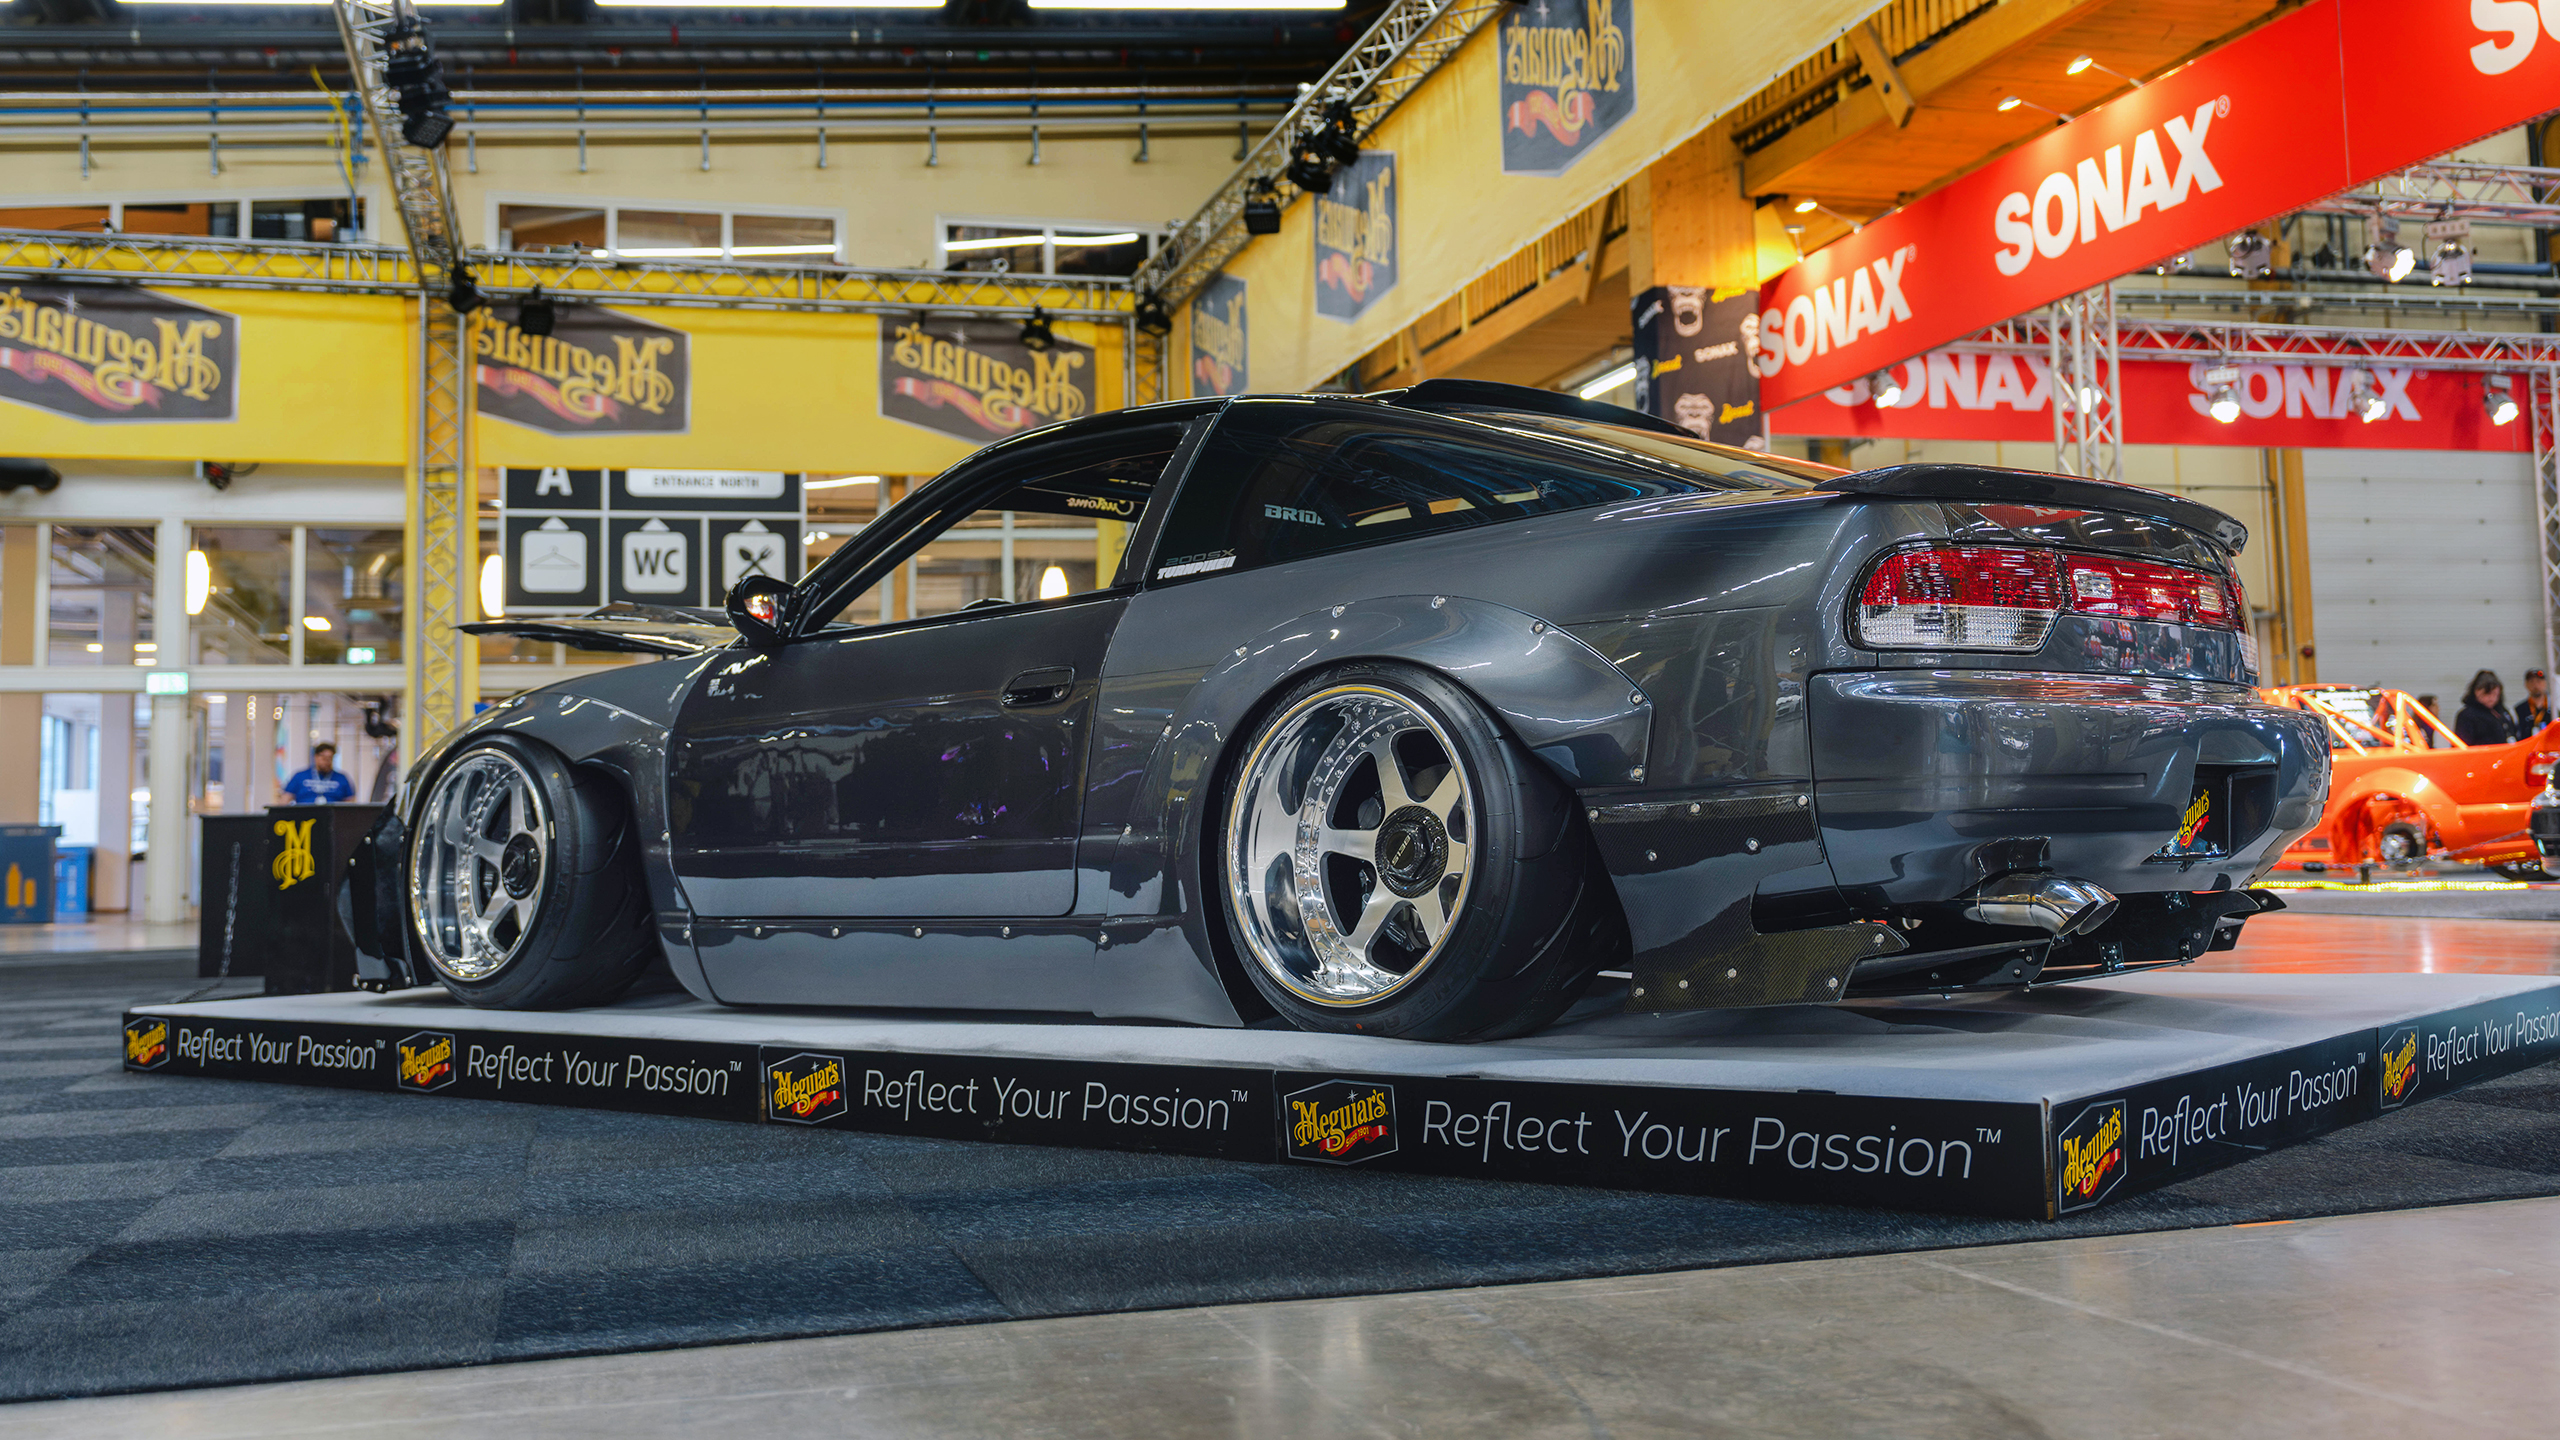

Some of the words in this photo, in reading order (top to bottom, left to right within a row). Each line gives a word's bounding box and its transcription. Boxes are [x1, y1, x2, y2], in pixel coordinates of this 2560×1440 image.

[653, 475, 714, 488] ENTRANCE
[720, 476, 760, 488] NORTH
[633, 549, 680, 576] WC
[1165, 548, 1235, 567] 200SX
[177, 1028, 243, 1067] Reflect
[249, 1032, 293, 1065] Your
[467, 1045, 553, 1089] Reflect
[562, 1050, 619, 1088] Your
[2427, 1026, 2479, 1080] Reflect
[2484, 1019, 2513, 1056] Your
[773, 1060, 839, 1114] Meguiar's
[864, 1069, 979, 1121] Reflect
[992, 1076, 1071, 1119] Your
[1292, 1089, 1386, 1152] Meguiar's
[1357, 1126, 1370, 1138] 1901
[1422, 1100, 1592, 1163] Reflect
[1614, 1110, 1731, 1163] Your
[2140, 1093, 2228, 1166] Reflect
[2236, 1082, 2283, 1130] Your
[2063, 1107, 2121, 1196] Meguiar's
